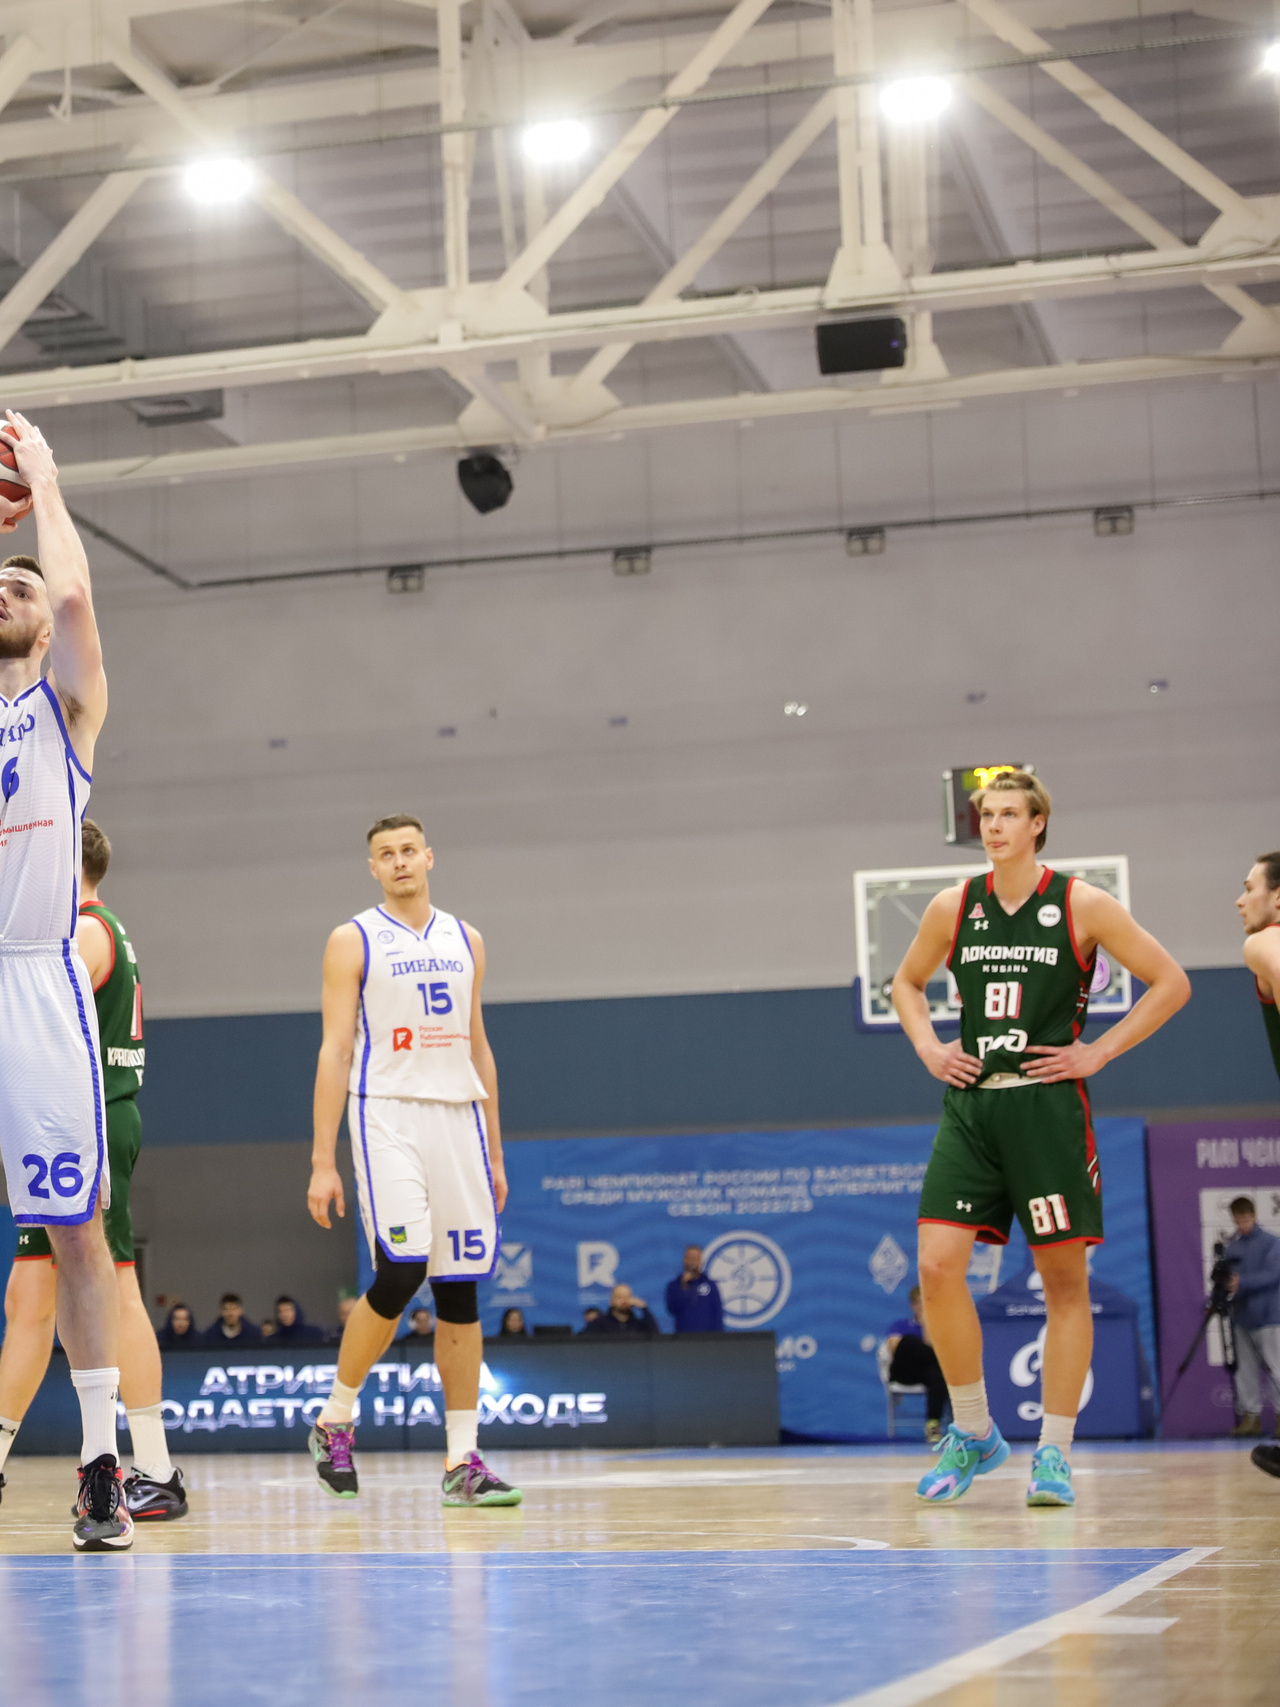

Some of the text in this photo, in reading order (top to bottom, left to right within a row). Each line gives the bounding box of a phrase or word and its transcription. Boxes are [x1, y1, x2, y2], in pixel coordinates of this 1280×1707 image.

[390, 958, 464, 977] ДИНАМО
[960, 945, 1059, 966] ЛОКОМОТИВ
[982, 964, 1029, 973] КУБАНЬ
[417, 981, 453, 1016] 15
[984, 980, 1022, 1019] 81
[22, 1152, 84, 1199] 26
[1028, 1193, 1071, 1236] 81
[447, 1228, 487, 1262] 15
[373, 1394, 443, 1427] НА
[476, 1392, 609, 1429] ХОДЕ
